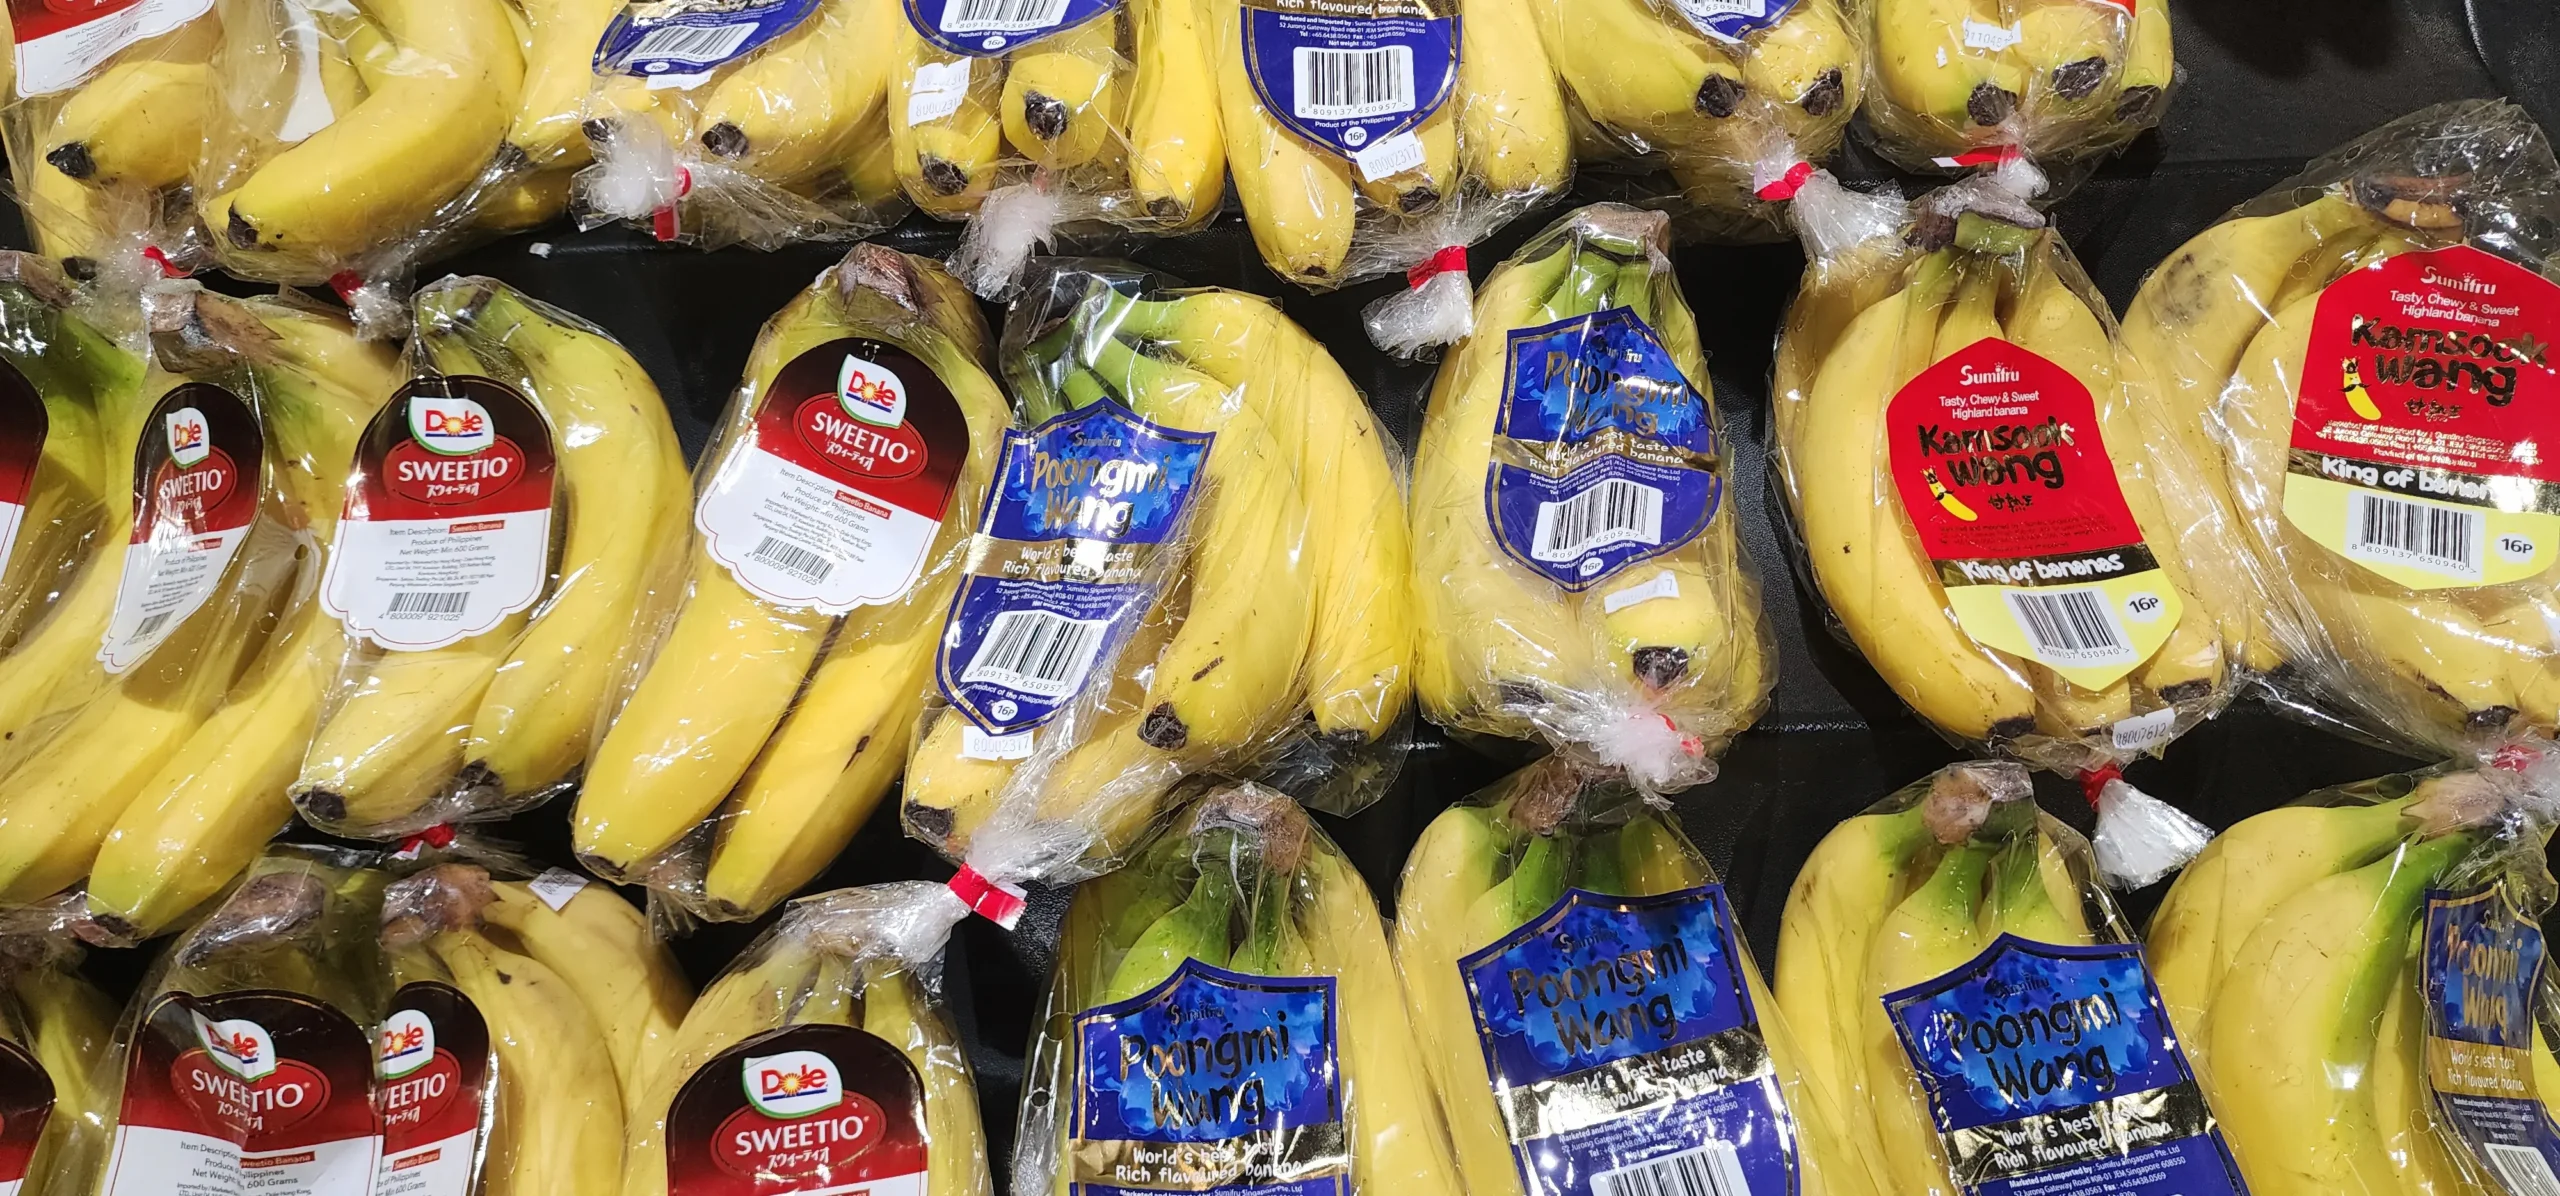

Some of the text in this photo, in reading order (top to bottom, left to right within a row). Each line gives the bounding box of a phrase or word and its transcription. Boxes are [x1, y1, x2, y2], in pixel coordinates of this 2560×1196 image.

[1311, 0, 1427, 15] flavoured banana
[1315, 121, 1340, 129] Product
[1361, 115, 1396, 125] Philippines
[1358, 103, 1397, 114] 650957
[2420, 266, 2497, 295] Sumifru
[2390, 290, 2520, 317] Tasty, Chewy & Sweet
[2402, 305, 2500, 328] Highland banana
[2351, 313, 2549, 368] Kamsook
[1960, 364, 2020, 386] Sumifru
[848, 370, 896, 408] Dole
[1939, 391, 2040, 409] Tasty, Chewy & Sweet
[425, 409, 484, 437] Dole
[1952, 405, 2029, 421] Highland banana
[174, 420, 203, 449] Dole
[811, 411, 910, 464] SWEETIO
[1595, 431, 1625, 443] best
[1630, 438, 1669, 452] taste
[1917, 416, 2075, 458] Kamsook
[398, 456, 509, 483] SWEETIO
[1529, 457, 1560, 473] Rich
[1630, 449, 1684, 465] banana
[2322, 457, 2378, 485] King
[2383, 468, 2416, 489] of
[161, 468, 222, 498] SWEETIO
[1031, 451, 1172, 499] Poongmi
[780, 468, 796, 481] Item
[837, 491, 864, 509] Sweetio
[863, 501, 890, 520] Banana
[794, 486, 866, 522] Produce Philippines
[781, 490, 870, 535] Net Weight: 600 Grams
[1044, 488, 1135, 540] Wang
[389, 528, 407, 537] Item
[478, 521, 503, 531] Banana
[411, 535, 482, 546] Produce Philippines
[1595, 530, 1639, 544] 650957
[468, 543, 490, 553] Grams
[1020, 544, 1061, 562] World's
[1598, 541, 1637, 555] Philippines
[2366, 545, 2466, 572] 809137 650940
[754, 555, 819, 587] 800009 921025
[1002, 559, 1030, 575] Rich
[1034, 563, 1091, 578] flavoured
[1959, 552, 2125, 584] King of bananas
[390, 612, 461, 622] 800009 921025
[2081, 648, 2120, 659] 650940
[978, 669, 1062, 693] 809137 650957
[1507, 924, 1689, 1017] Poongmi
[1551, 994, 1678, 1058] Wang
[1940, 976, 2123, 1063] Poongmi
[1118, 1010, 1291, 1082] Poongmi
[1662, 1048, 1706, 1074] taste
[761, 1064, 828, 1097] Dole
[1985, 1043, 2117, 1110] Wang
[192, 1067, 304, 1114] SWEETIO
[1151, 1076, 1266, 1130] Wang
[735, 1115, 864, 1157] SWEETIO
[1559, 1128, 1590, 1144] Marketed
[2060, 1111, 2100, 1136] best
[180, 1141, 312, 1165] Item Banana
[1133, 1148, 1193, 1165] World's
[1993, 1150, 2028, 1172] Rich
[2031, 1134, 2109, 1166] flavoured
[192, 1168, 298, 1189] Net 600 Grams
[1115, 1165, 1151, 1183] Rich
[1158, 1165, 1238, 1184] flavoured
[2009, 1146, 2181, 1190] Marketed and Imported Sumifru Singapore Pte. Ltd
[2044, 1182, 2072, 1196] Gateway
[2072, 1177, 2090, 1187] Road
[2125, 1163, 2161, 1178] Singapore
[2161, 1156, 2186, 1170] 608550
